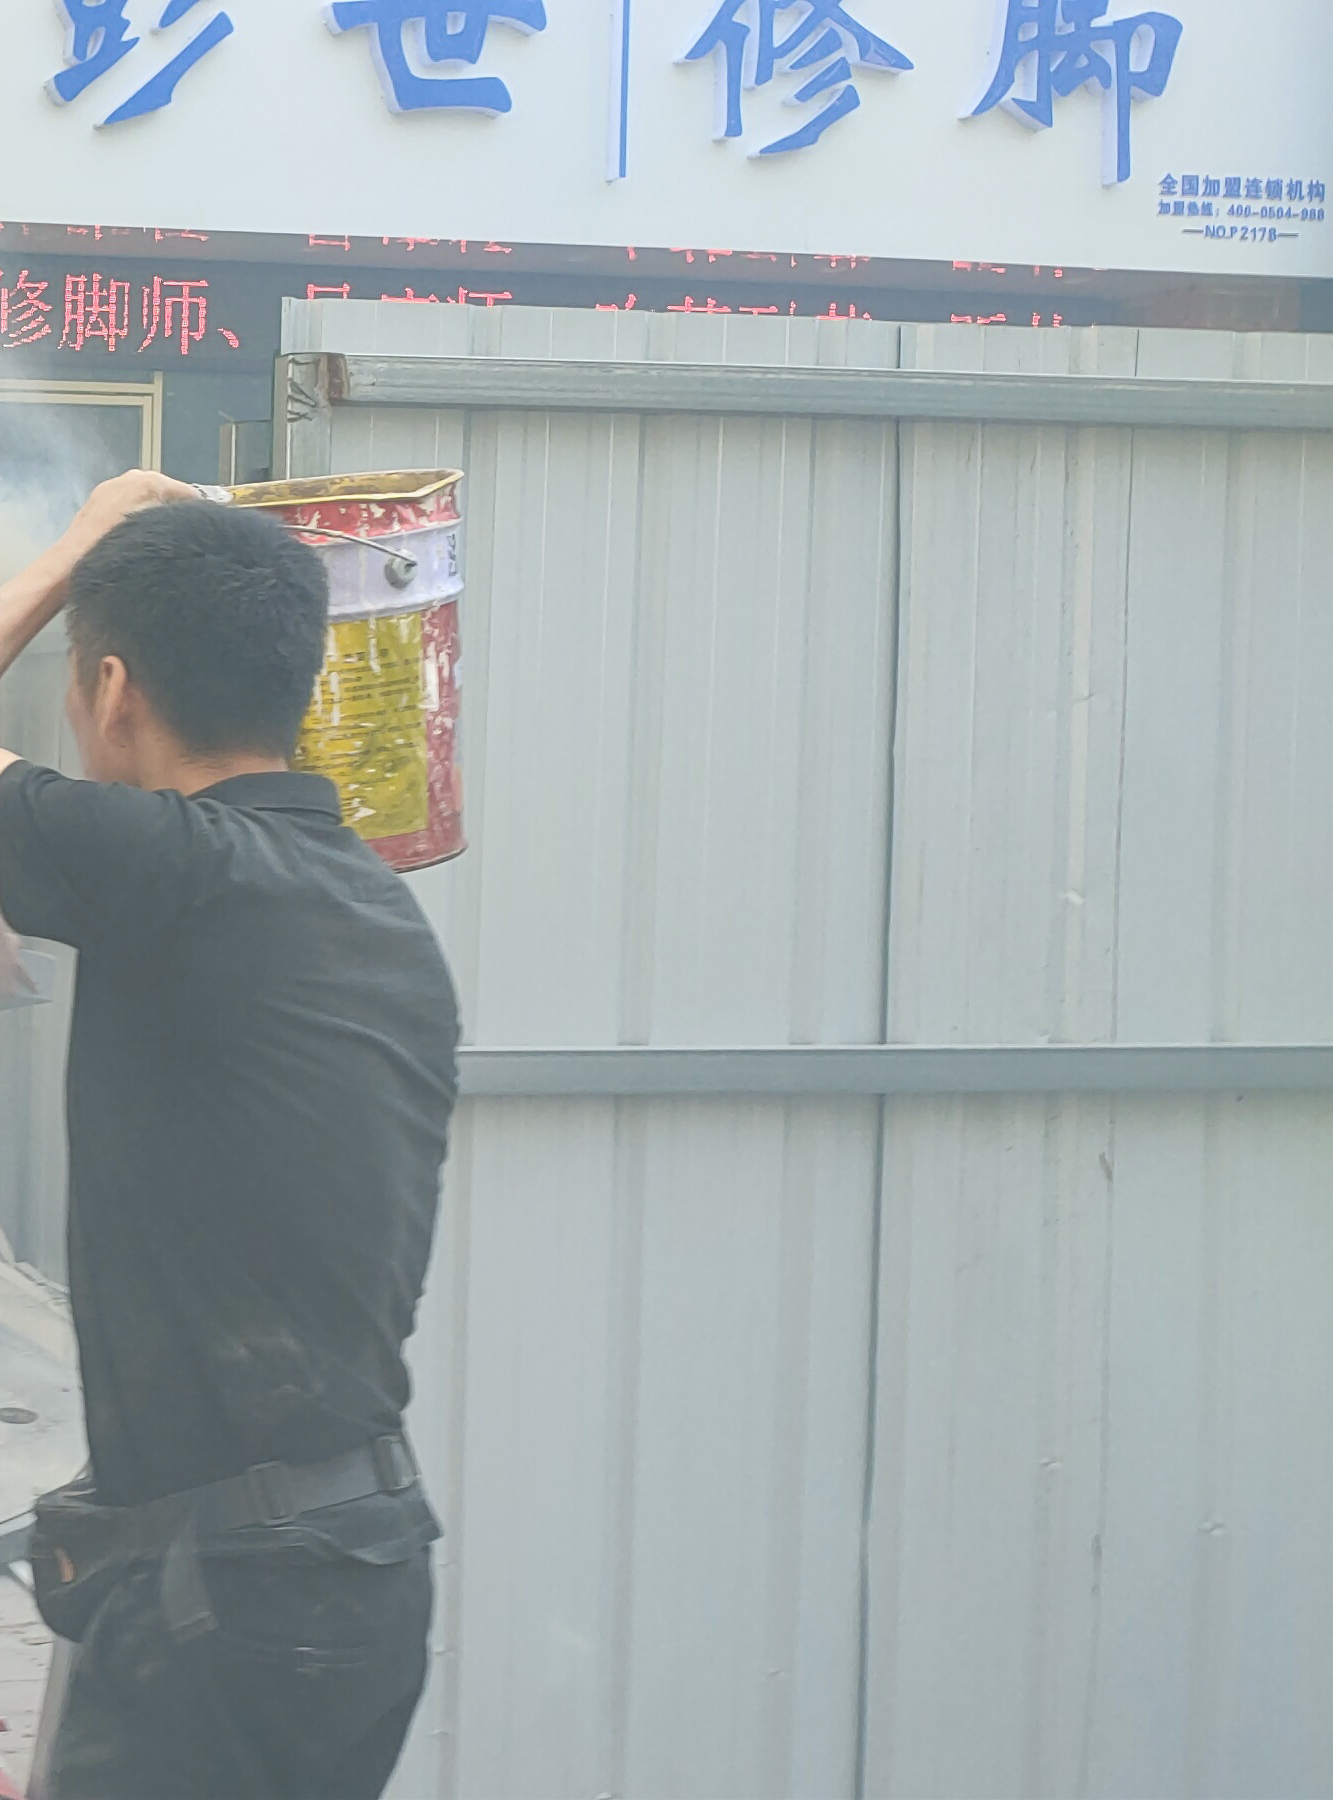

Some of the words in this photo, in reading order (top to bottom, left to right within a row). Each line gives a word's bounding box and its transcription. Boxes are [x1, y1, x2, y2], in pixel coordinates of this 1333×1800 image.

[1158, 173, 1326, 203] 全国加盟连锁机构
